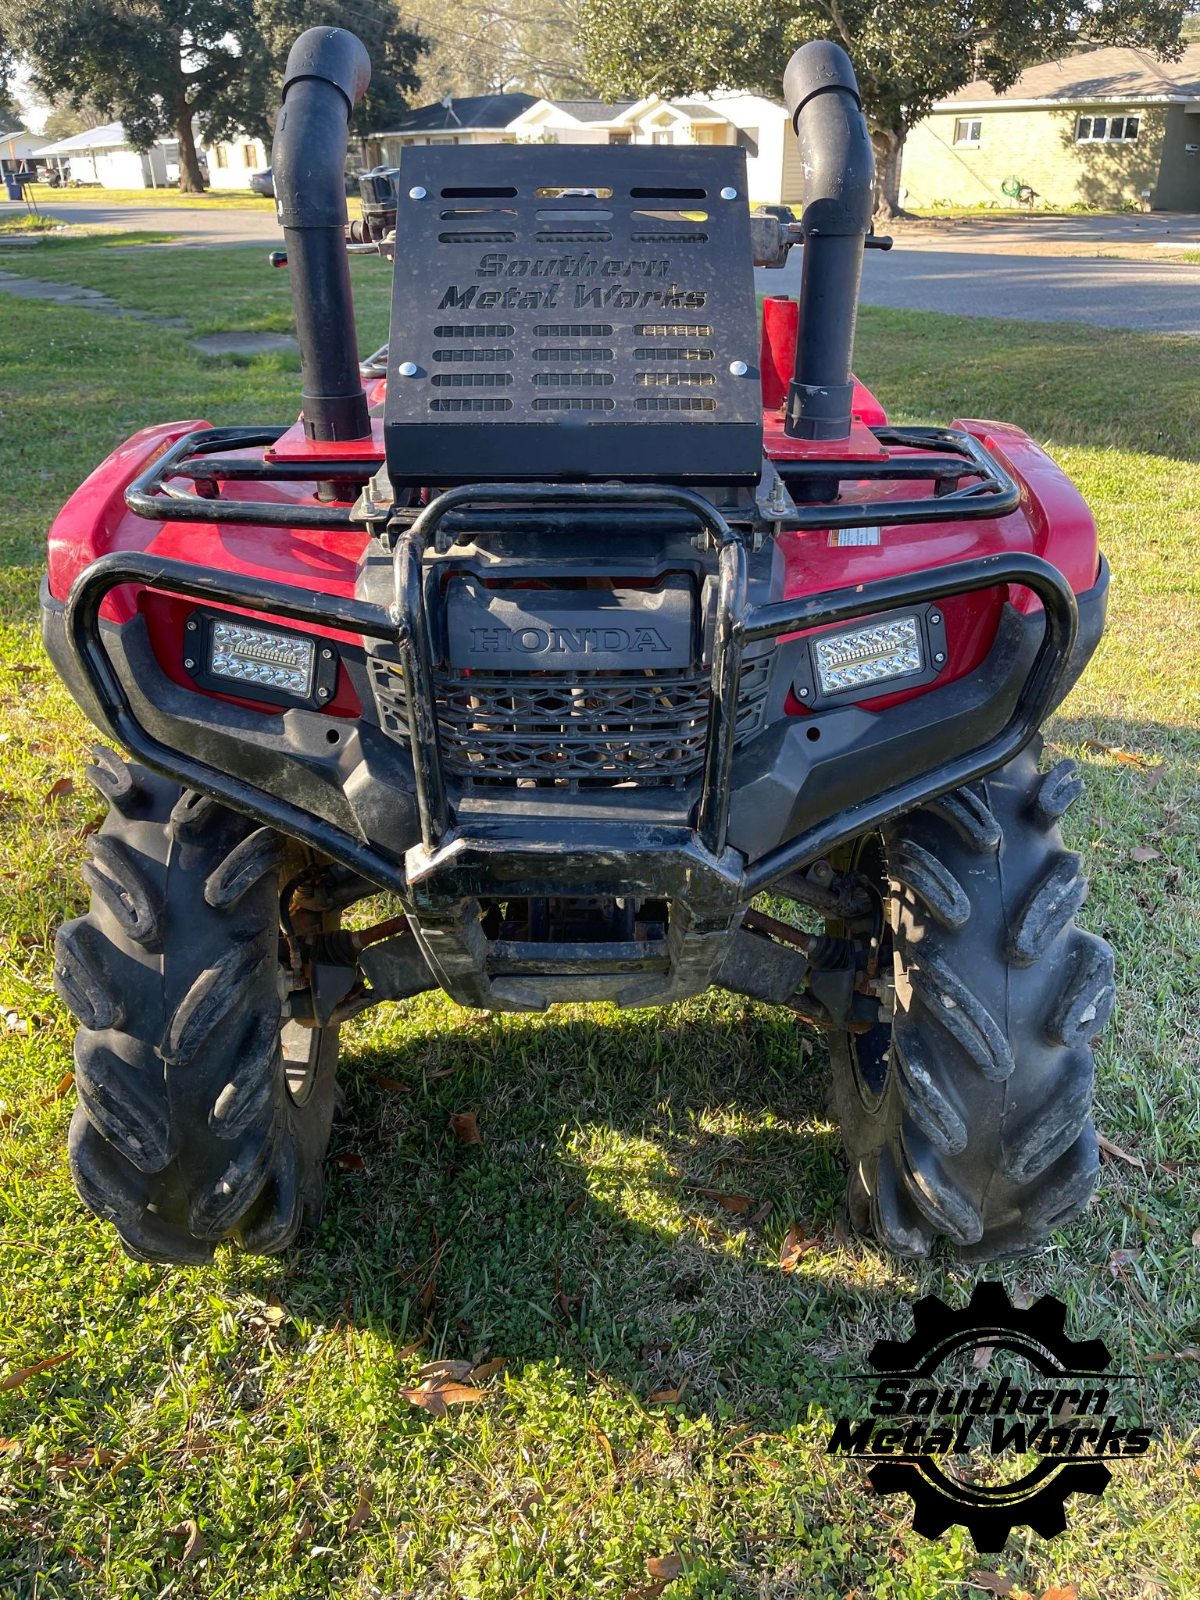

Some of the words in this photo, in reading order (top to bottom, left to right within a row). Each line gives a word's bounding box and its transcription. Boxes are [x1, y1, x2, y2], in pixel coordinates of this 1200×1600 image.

[475, 252, 672, 277] Southern
[437, 283, 560, 310] Metal
[574, 283, 708, 310] Works
[470, 627, 671, 653] HONDA
